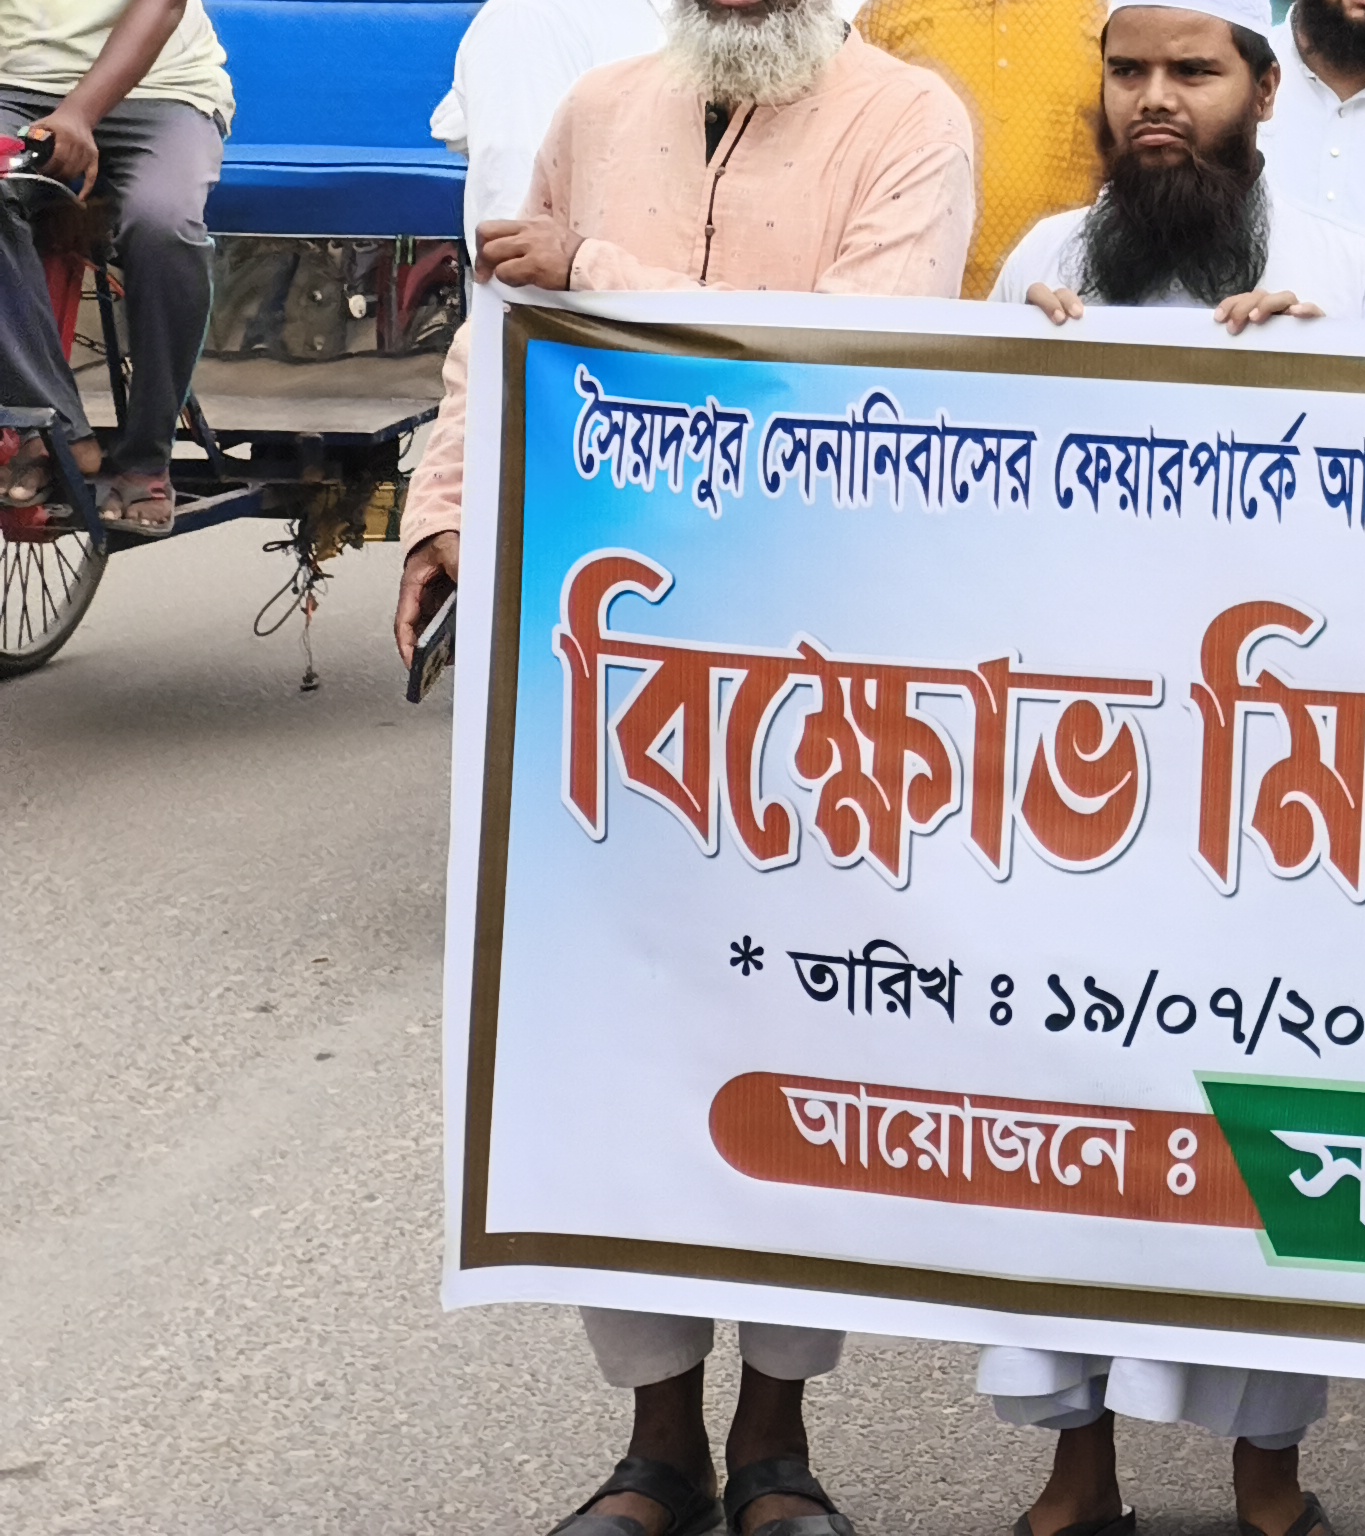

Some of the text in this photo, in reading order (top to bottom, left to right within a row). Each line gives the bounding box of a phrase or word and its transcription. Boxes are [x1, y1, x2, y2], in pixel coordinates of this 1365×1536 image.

[573, 363, 748, 515] সৈয়দপুর
[763, 392, 1037, 505] সেনানিবাসের
[1055, 413, 1306, 519] ফেয়ারপার্কে
[564, 559, 1152, 871] বিক্ষোভ
[787, 939, 962, 1022] তারিখ
[773, 1079, 1140, 1202] আয়োজনে
